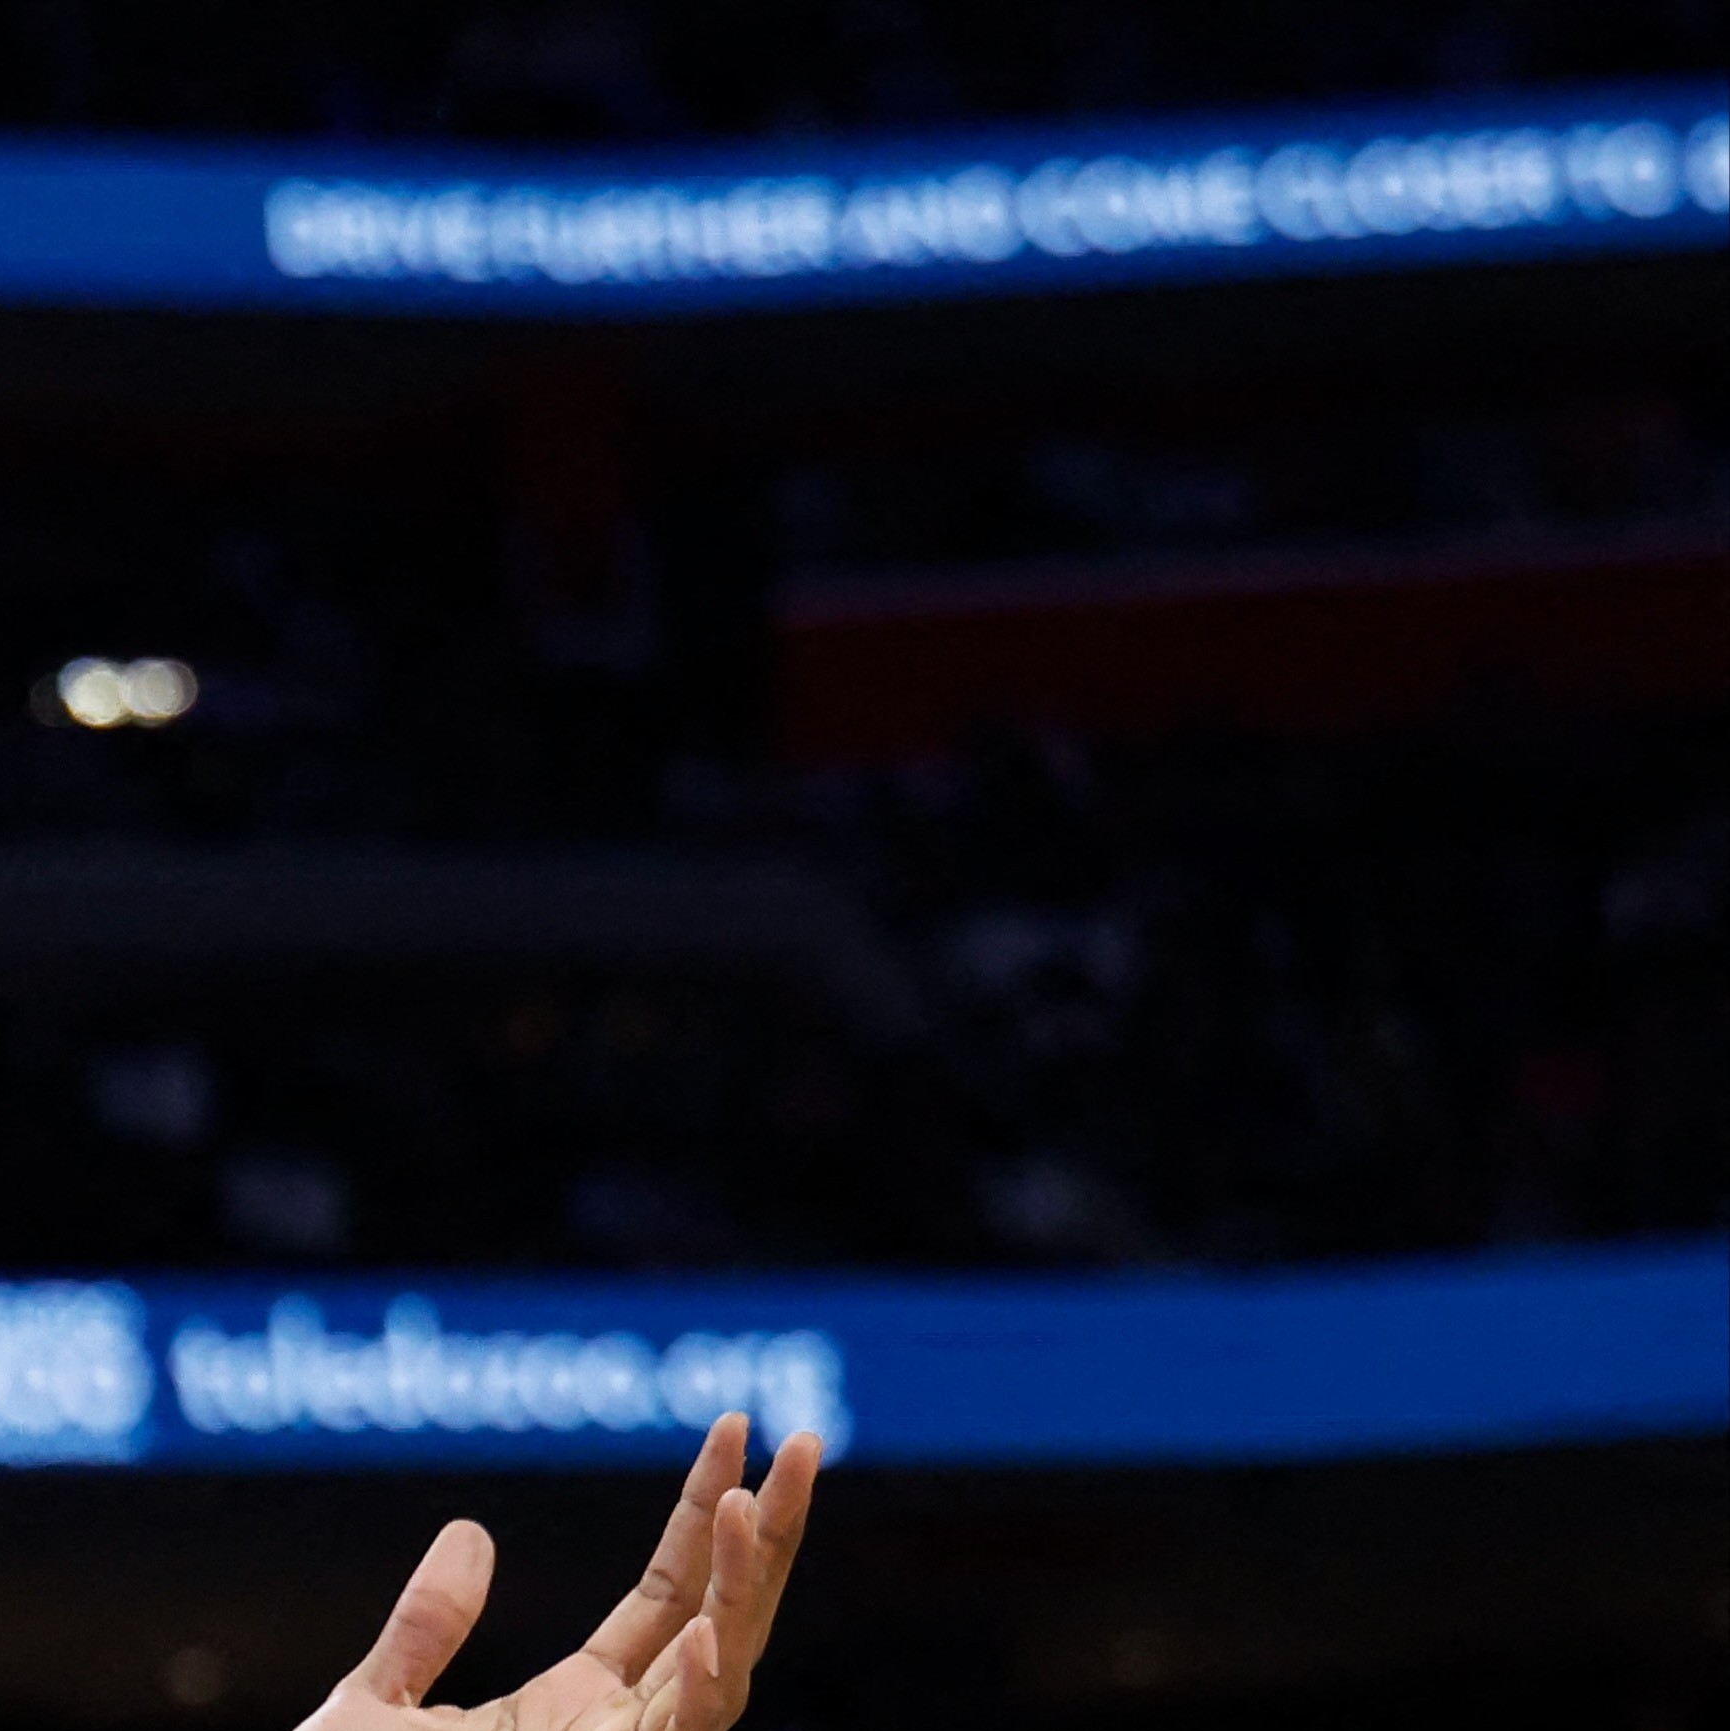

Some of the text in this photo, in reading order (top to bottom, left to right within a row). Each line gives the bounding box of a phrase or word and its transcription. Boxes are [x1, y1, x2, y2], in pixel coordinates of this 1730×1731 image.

[265, 175, 504, 283] DRIVE
[497, 172, 844, 284] FURTHER
[843, 162, 1025, 265] AND
[1019, 145, 1261, 259] COME
[1255, 128, 1563, 242] CLOSER
[1565, 121, 1680, 221] TO
